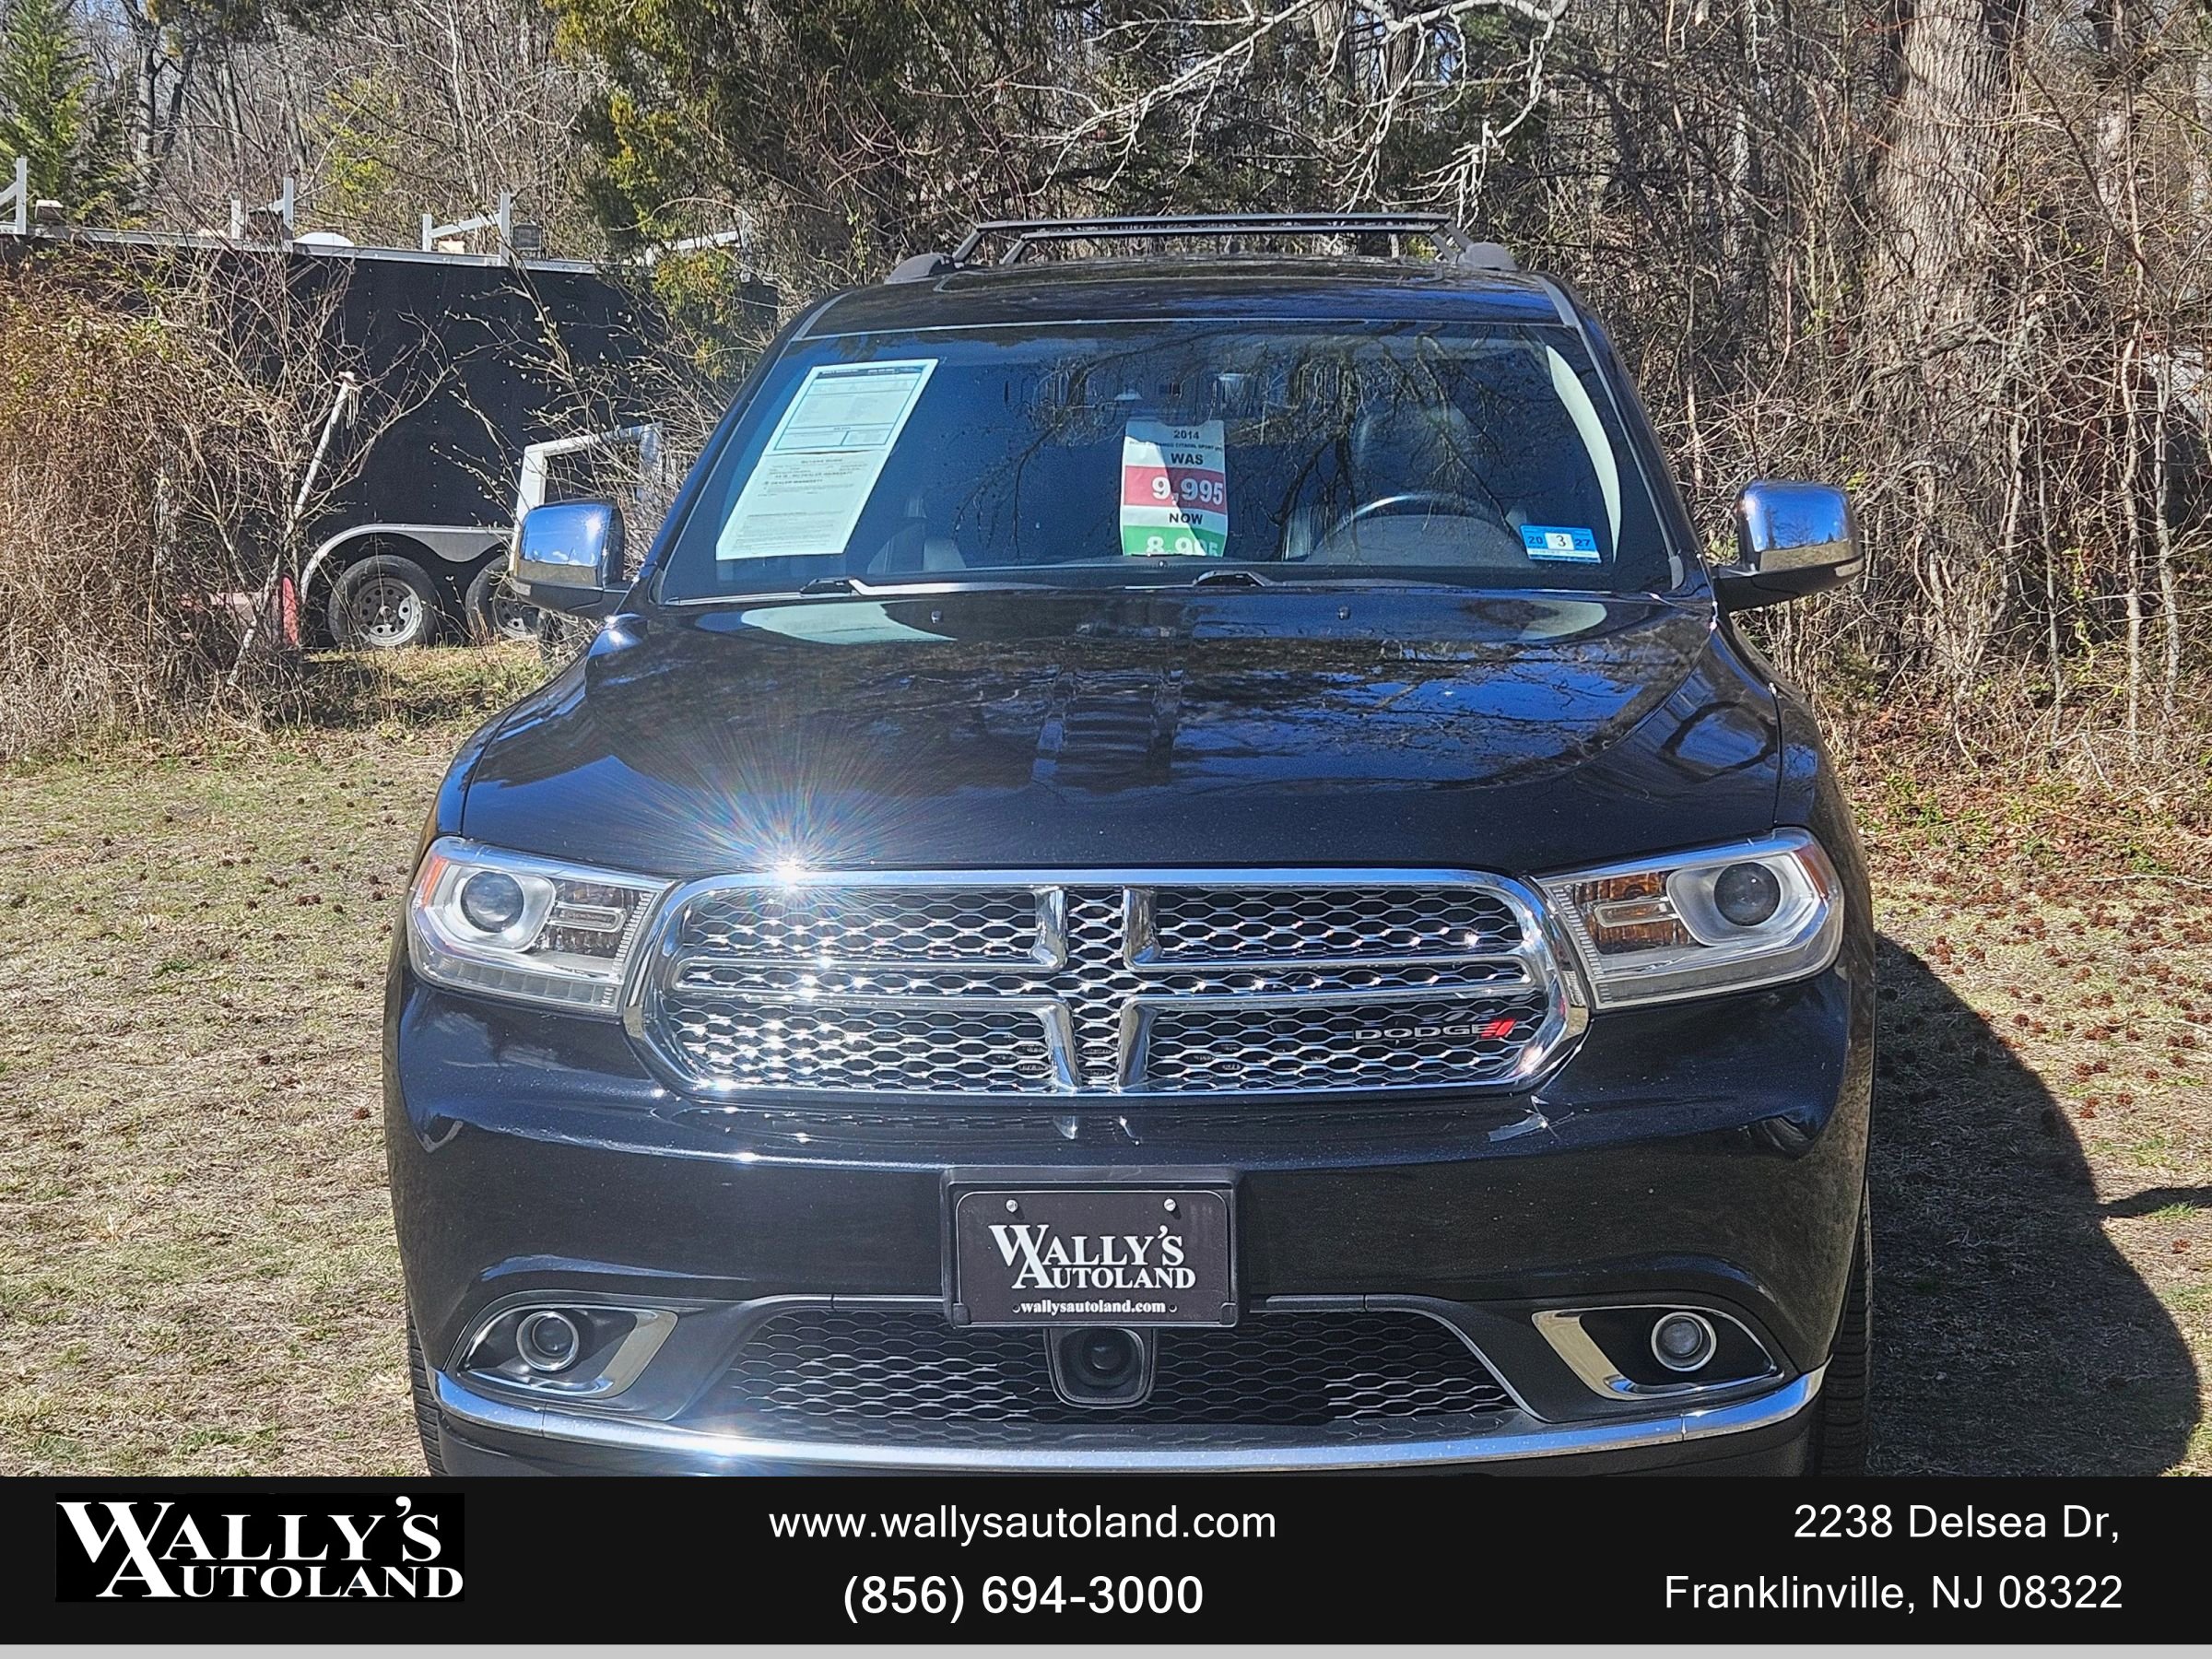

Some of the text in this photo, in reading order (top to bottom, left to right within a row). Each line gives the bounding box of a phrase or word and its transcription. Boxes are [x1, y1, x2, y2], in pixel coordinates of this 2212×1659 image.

[1173, 429, 1200, 440] 2014
[1171, 453, 1204, 465] WAS
[1152, 477, 1223, 505] 9,995
[1169, 512, 1204, 525] NOW
[1146, 536, 1218, 556] 8995
[1528, 535, 1591, 547] 20 3 27
[1355, 1023, 1497, 1041] DODGE
[988, 1224, 1185, 1266] WALLY'S
[1011, 1263, 1196, 1289] AUTOLAND
[1020, 1300, 1166, 1316] wallysautoland.com
